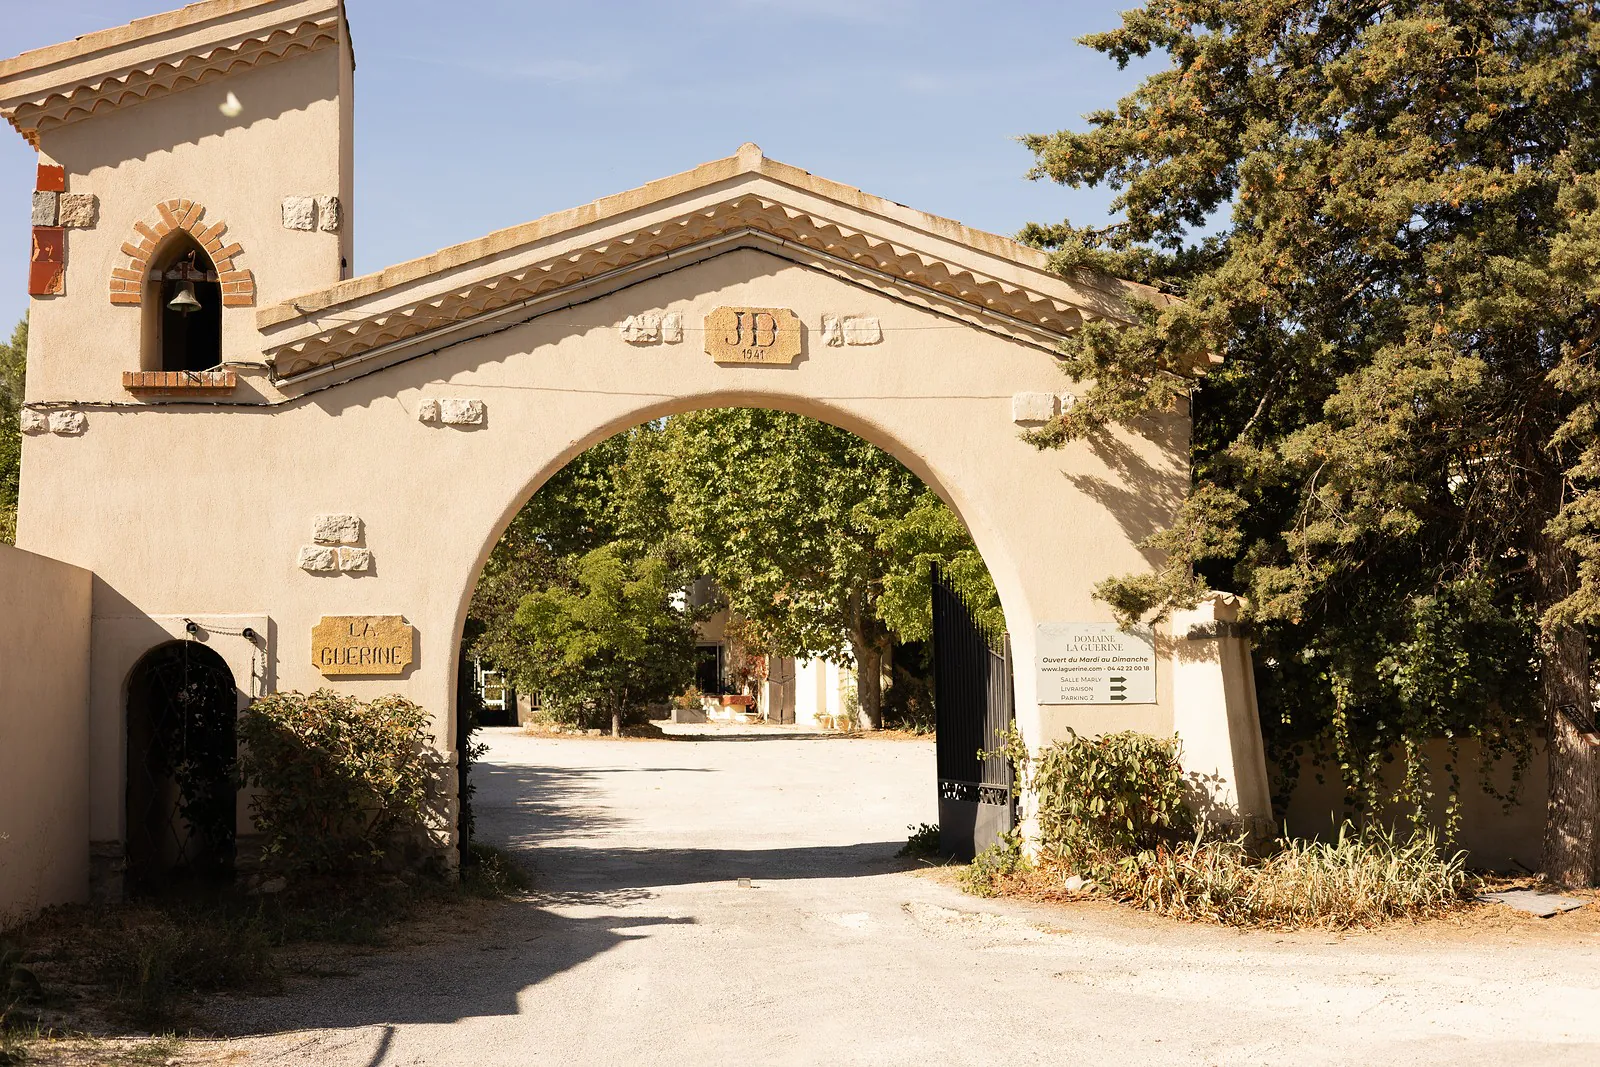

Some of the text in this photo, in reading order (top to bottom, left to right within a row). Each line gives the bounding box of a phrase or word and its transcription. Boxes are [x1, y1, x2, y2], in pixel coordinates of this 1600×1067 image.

[725, 312, 779, 347] JD
[742, 349, 764, 360] 1941
[349, 623, 376, 637] LA
[1080, 643, 1124, 652] GUERINE
[322, 646, 402, 665] GUERINE
